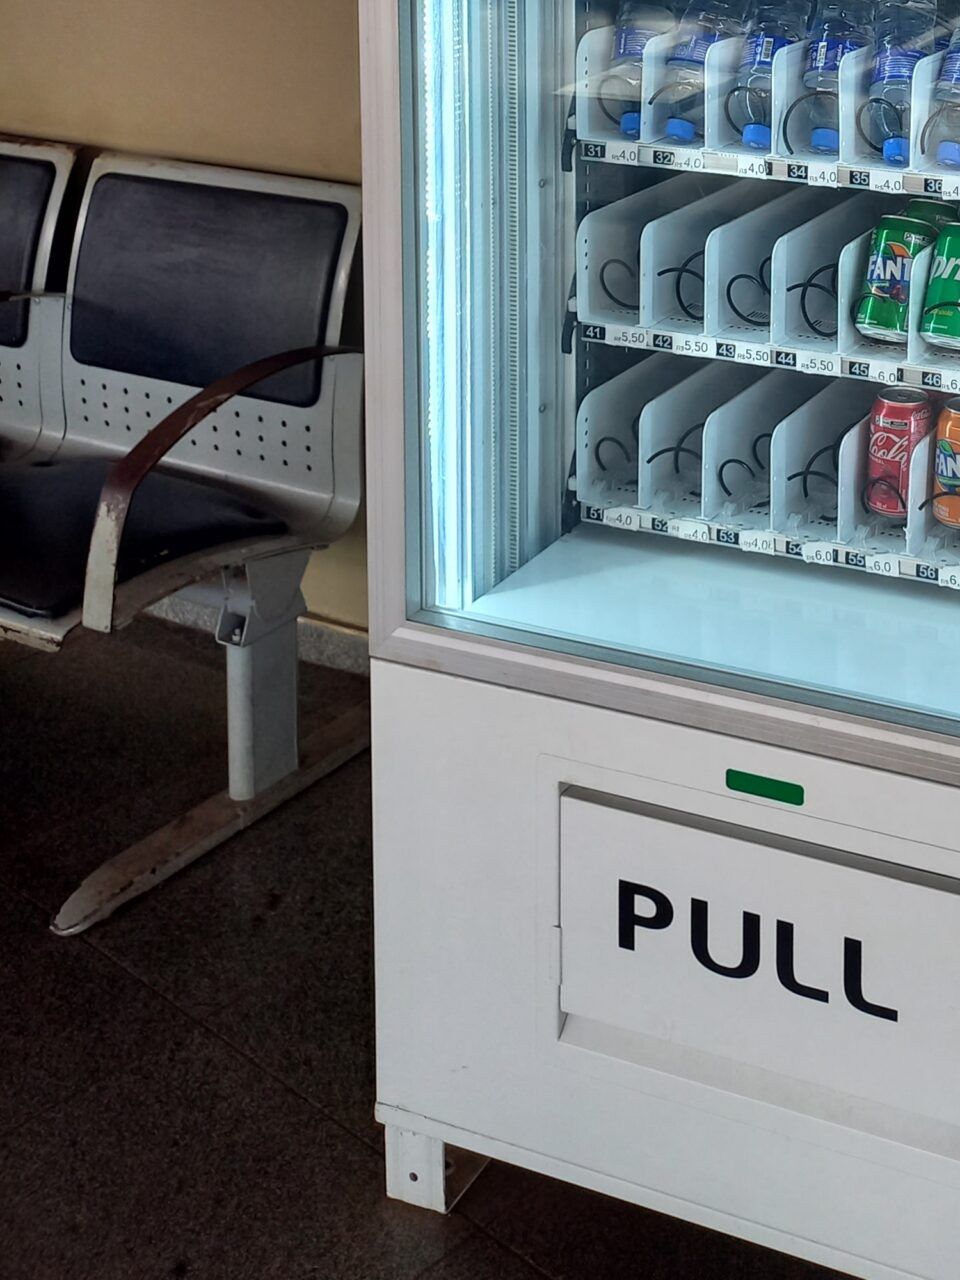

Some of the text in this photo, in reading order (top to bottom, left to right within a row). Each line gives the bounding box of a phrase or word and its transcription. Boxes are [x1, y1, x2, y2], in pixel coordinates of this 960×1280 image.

[587, 143, 600, 157] 31
[655, 151, 671, 164] 32
[790, 165, 807, 178] 34
[852, 171, 869, 184] 35
[926, 179, 943, 193] 36
[867, 253, 912, 282] FANT
[585, 326, 600, 339] 41
[654, 335, 672, 349] 42
[718, 343, 735, 357] 43
[777, 353, 795, 366] 44
[851, 363, 869, 376] 45
[924, 373, 941, 387] 46
[719, 530, 736, 543] 53
[848, 553, 865, 565] 55
[919, 566, 936, 579] 56
[618, 878, 899, 1023] PULL
